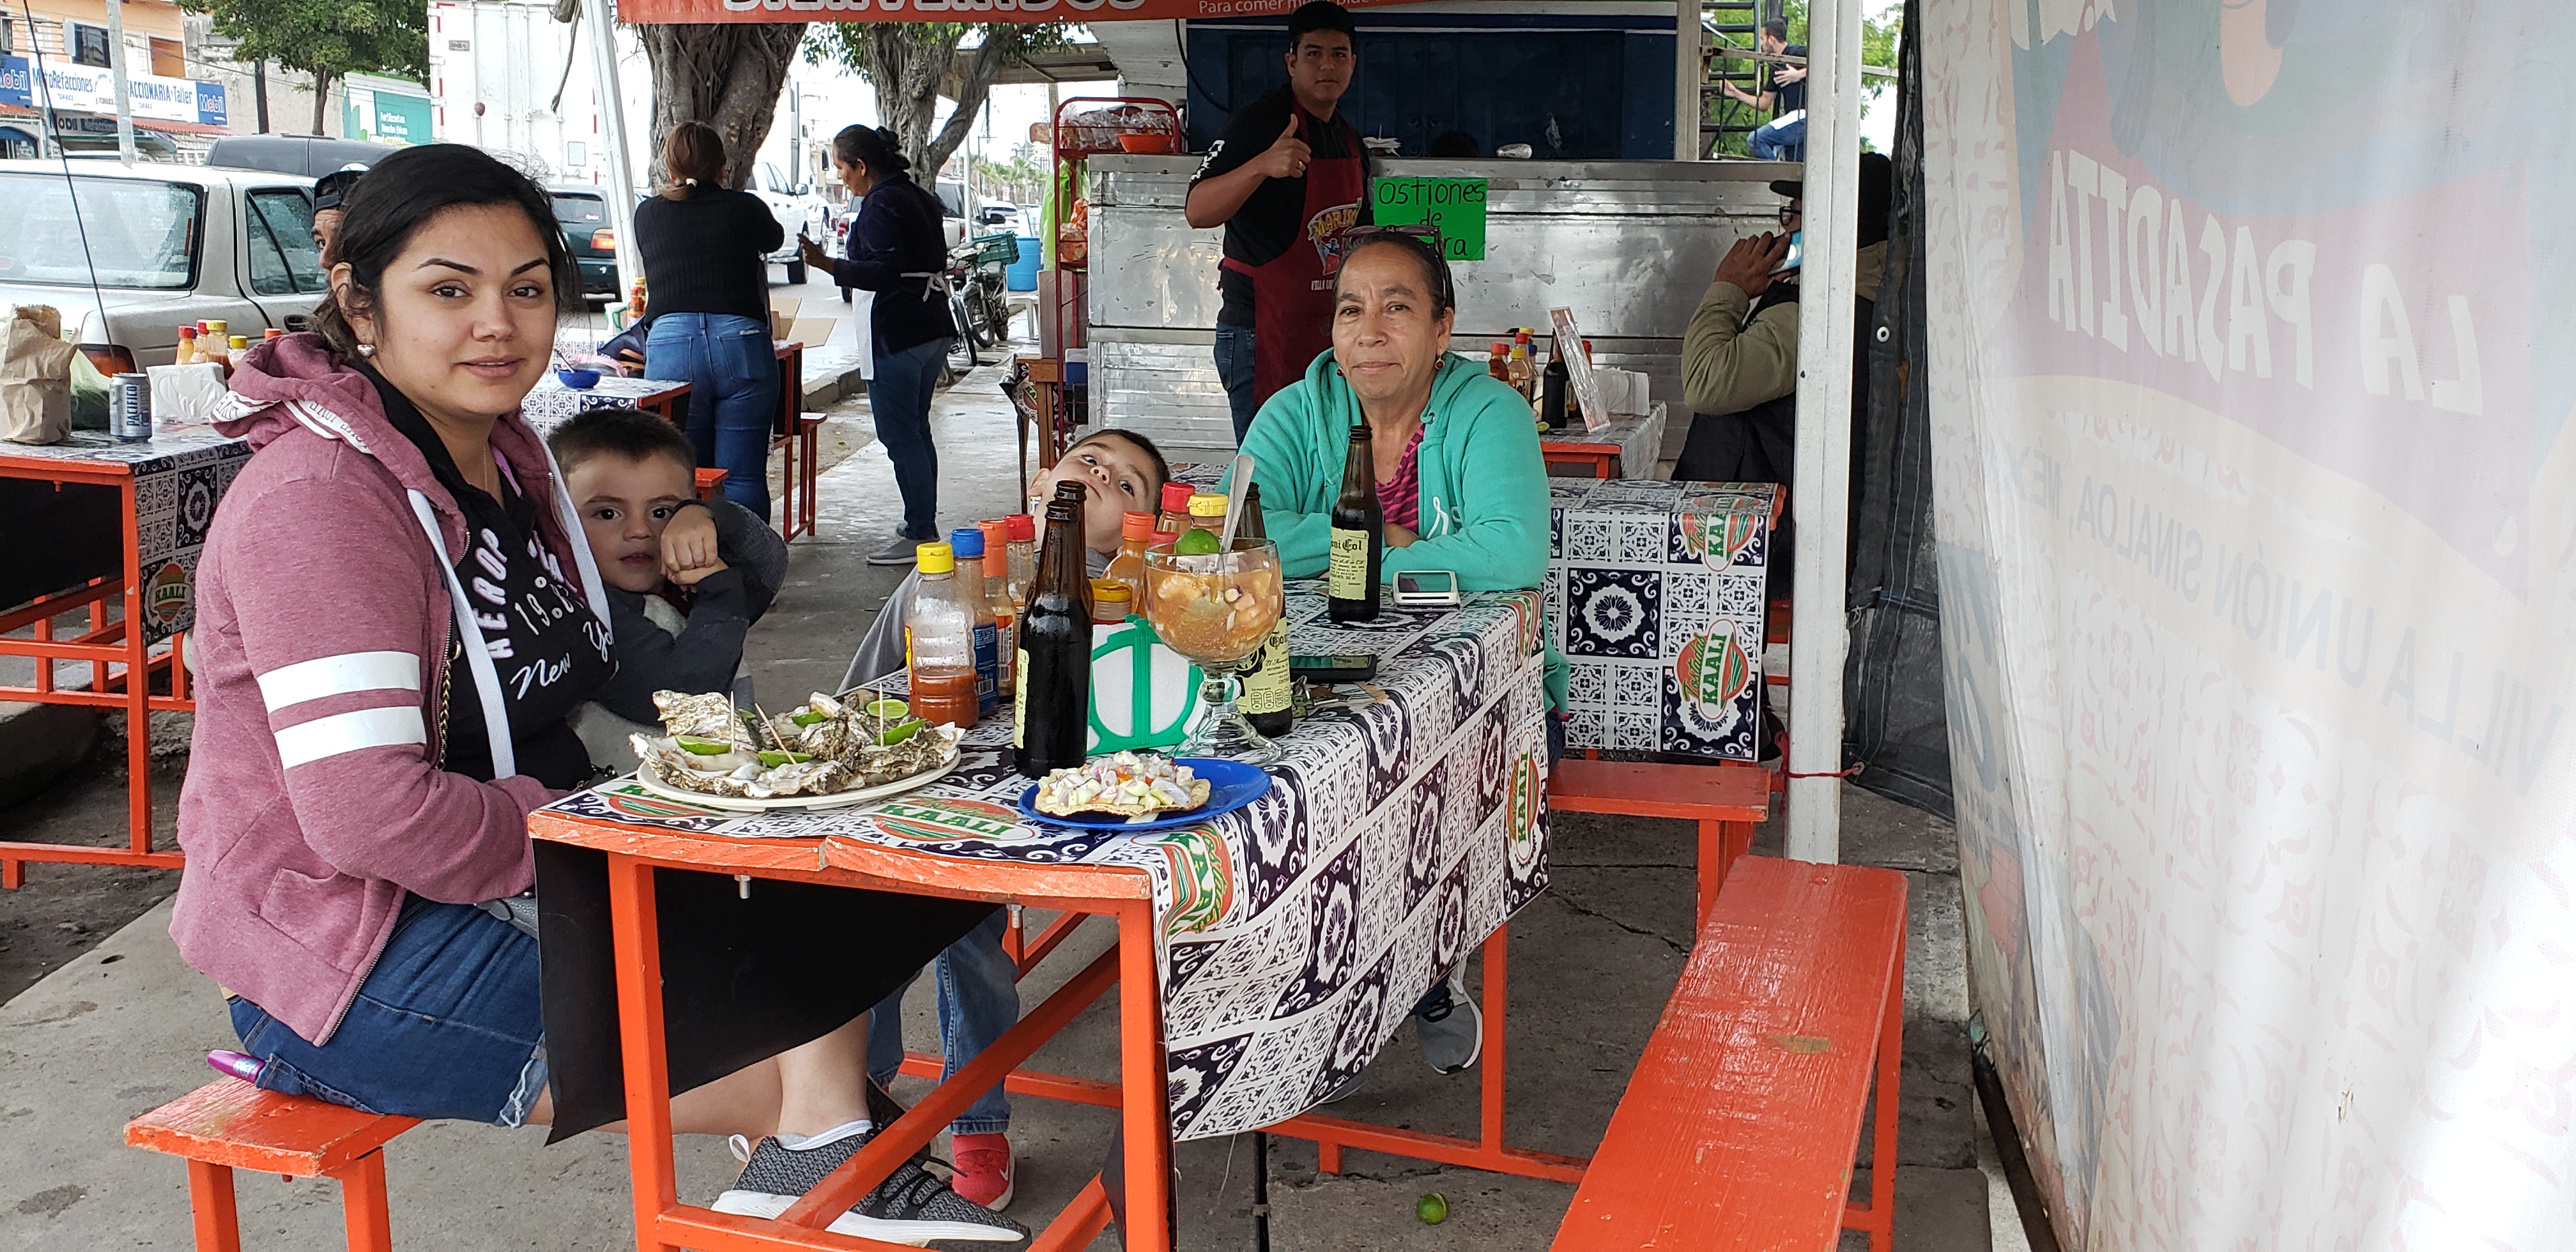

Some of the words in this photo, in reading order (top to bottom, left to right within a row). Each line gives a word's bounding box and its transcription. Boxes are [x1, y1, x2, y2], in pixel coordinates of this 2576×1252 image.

[1198, 1, 1232, 14] Para
[32, 67, 93, 93] MtoRefacciones
[172, 85, 193, 105] Taller
[199, 93, 225, 114] Mobil
[1379, 179, 1486, 206] Ostiones
[1419, 208, 1443, 227] de
[126, 386, 140, 426] PACIFICO
[155, 586, 186, 604] KAALI
[1683, 632, 1707, 702] Tostadas
[1702, 633, 1728, 706] KAALI
[873, 804, 1019, 836] KAALI
